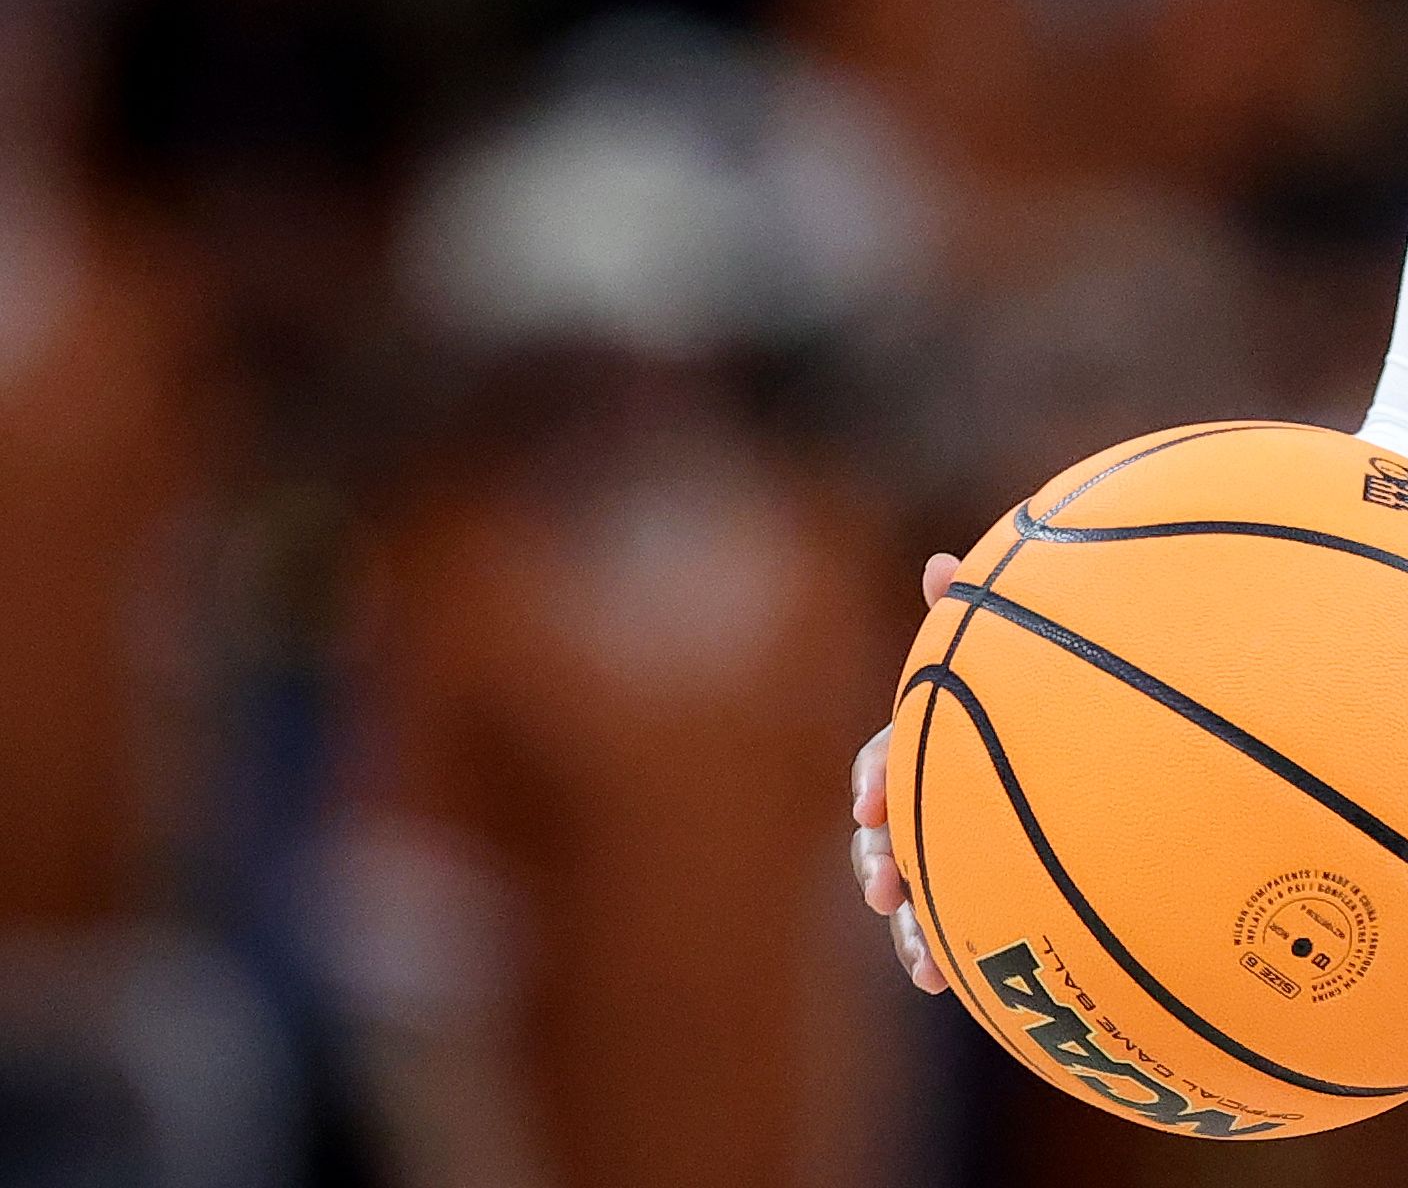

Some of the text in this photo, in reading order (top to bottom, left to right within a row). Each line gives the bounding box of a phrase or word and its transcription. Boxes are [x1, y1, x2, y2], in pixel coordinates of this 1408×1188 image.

[975, 939, 1286, 1137] NCAA
[1042, 934, 1305, 1121] OFFICIAL GAME BALL
[1246, 956, 1295, 995] SIZE 6
